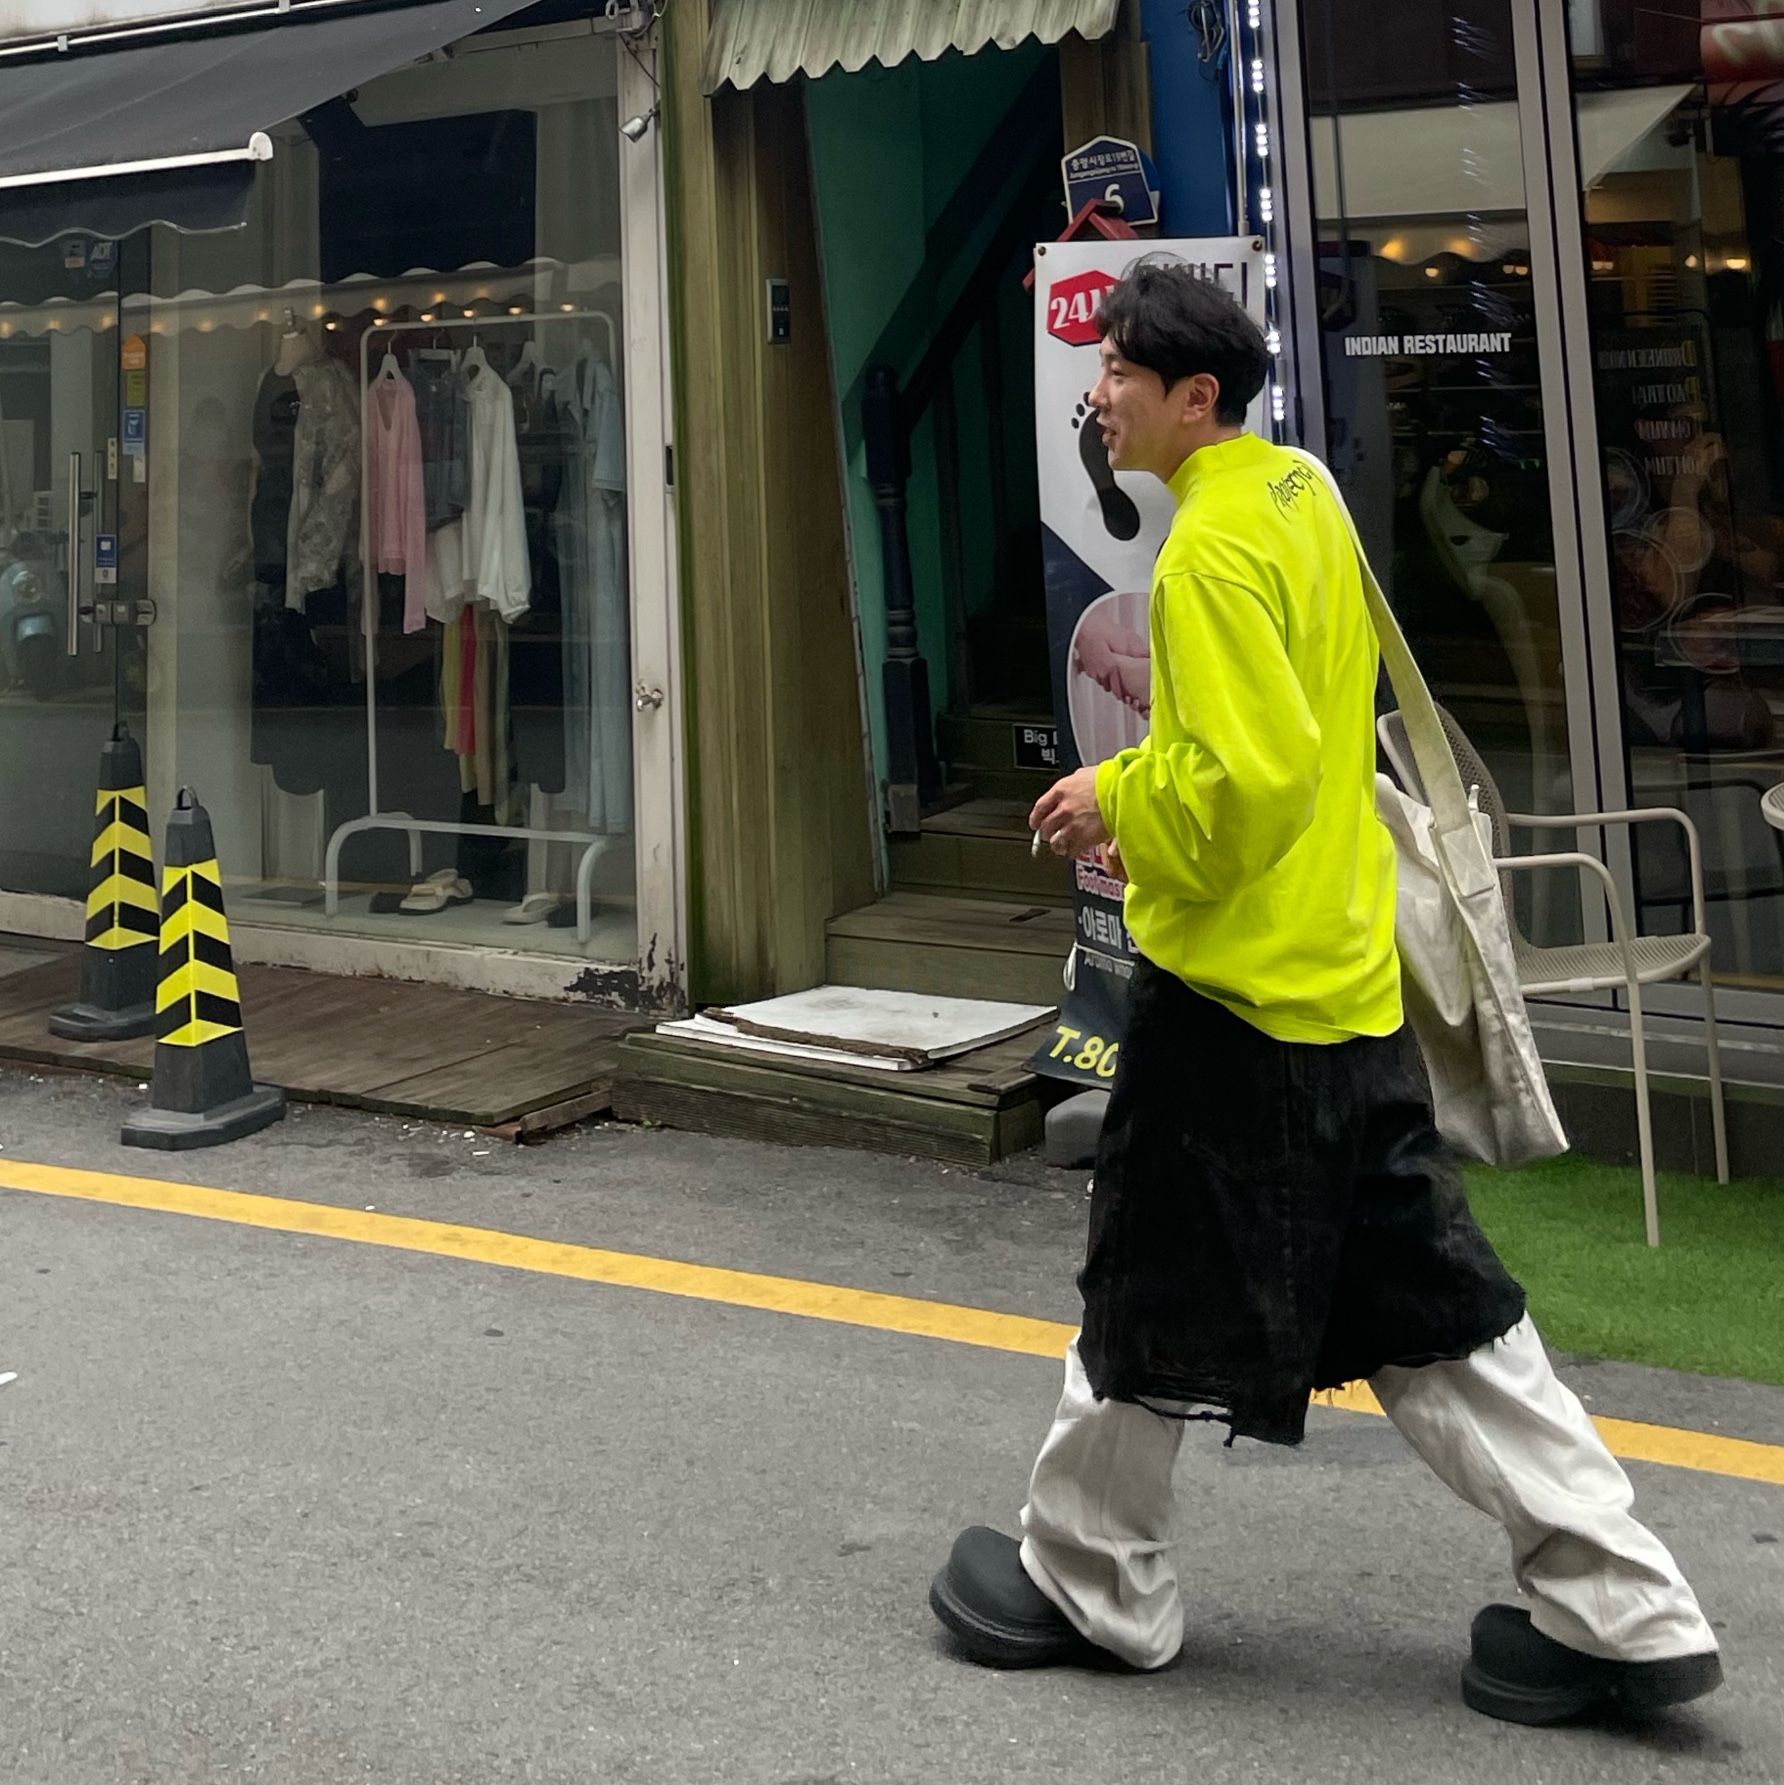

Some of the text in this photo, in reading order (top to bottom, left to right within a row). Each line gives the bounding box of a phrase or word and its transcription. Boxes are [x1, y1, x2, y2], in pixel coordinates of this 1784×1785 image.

[1105, 183, 1124, 215] 6
[1345, 333, 1512, 356] INDIAN RESTAURANT
[1024, 729, 1048, 747] Big
[1041, 748, 1060, 765] 빅
